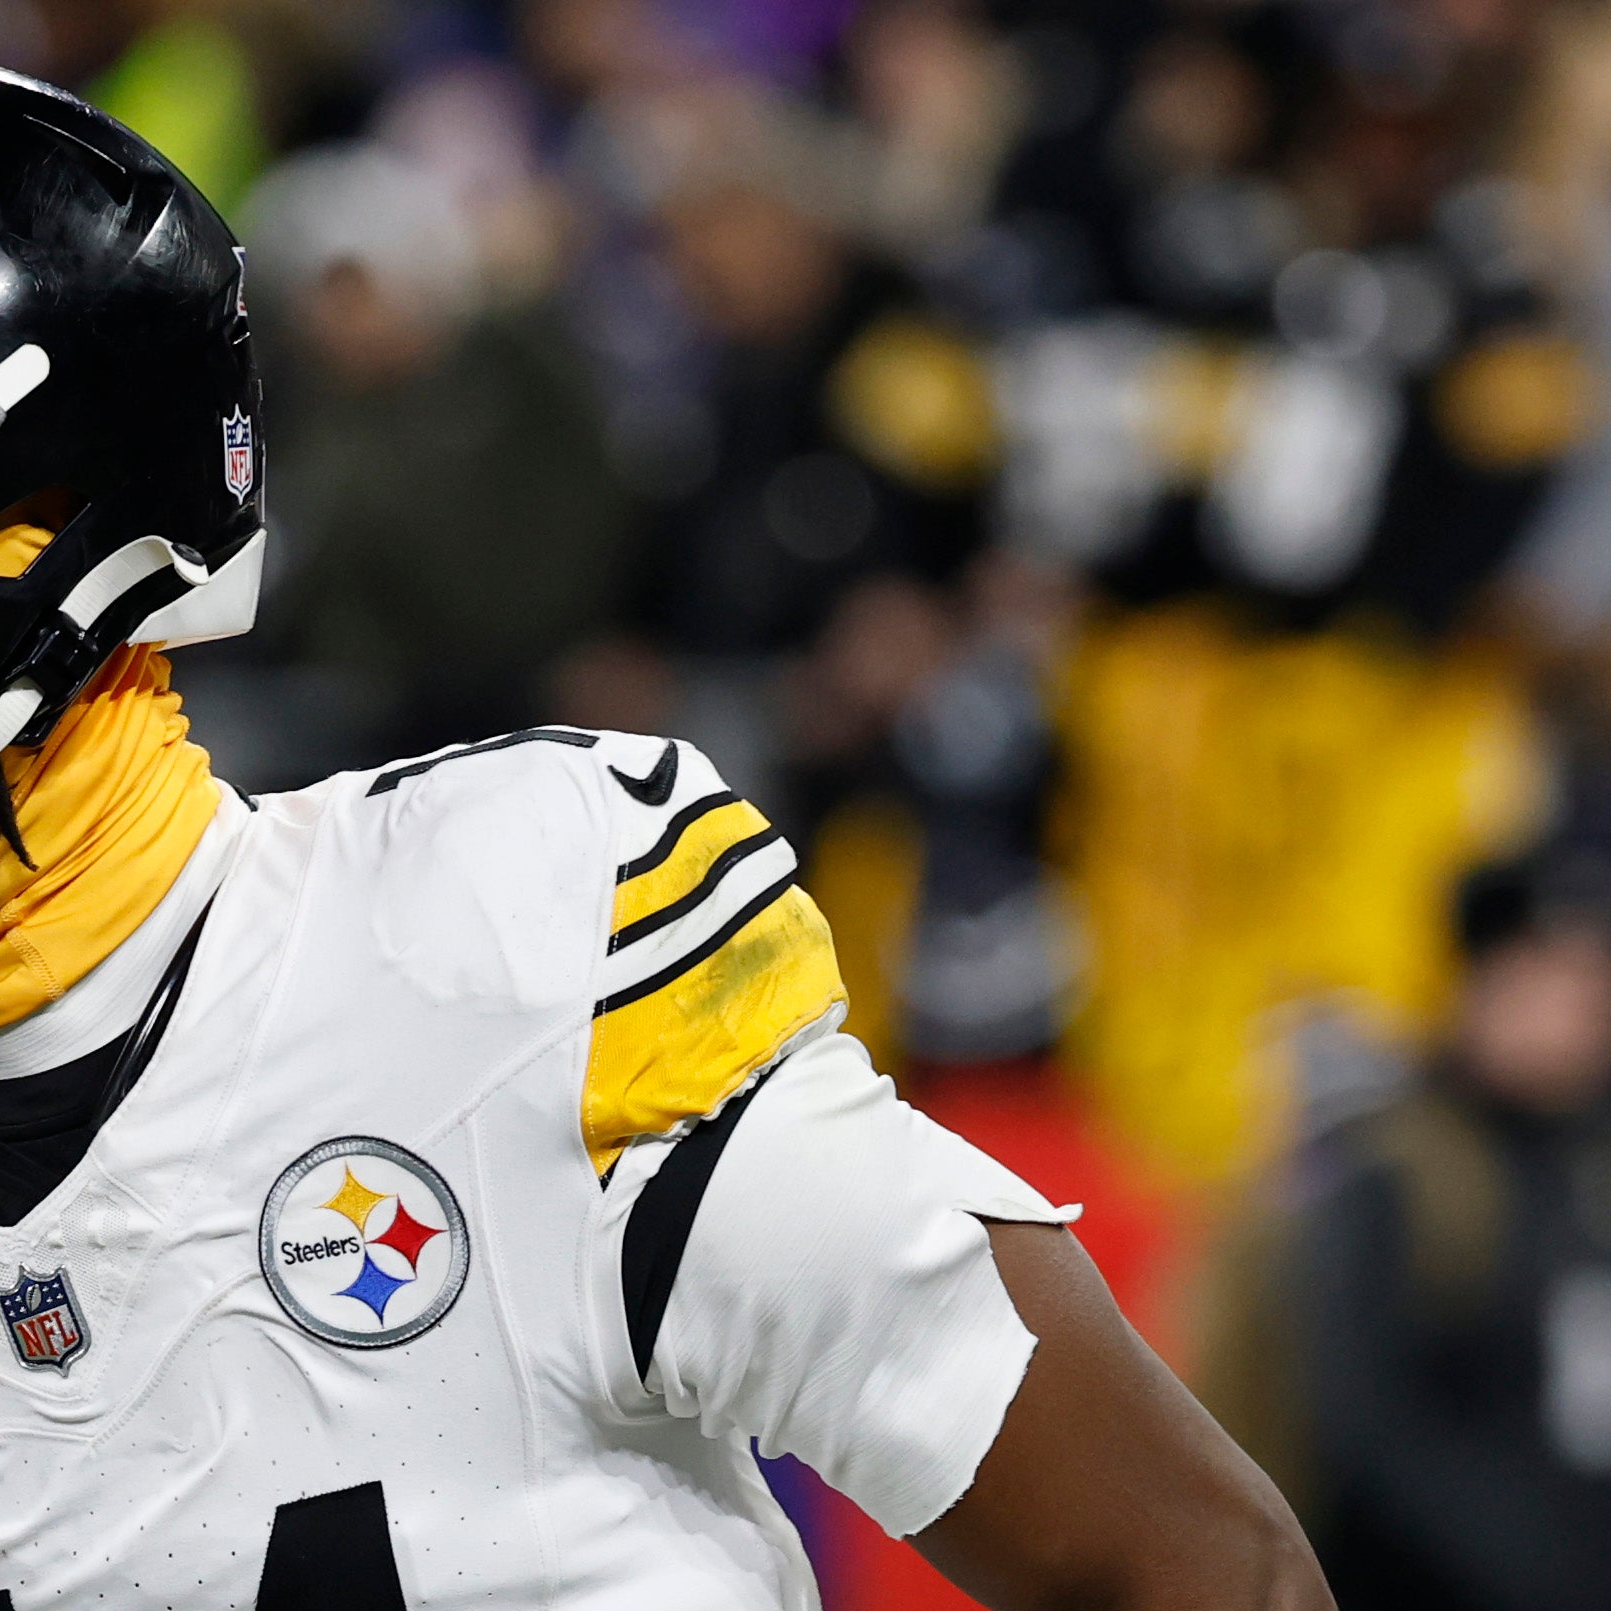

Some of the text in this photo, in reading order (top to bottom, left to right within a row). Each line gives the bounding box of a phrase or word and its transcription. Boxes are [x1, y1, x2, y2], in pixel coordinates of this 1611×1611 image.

[230, 449, 252, 486] NFL
[281, 1236, 360, 1265] Steelers
[16, 1310, 79, 1357] NFL
